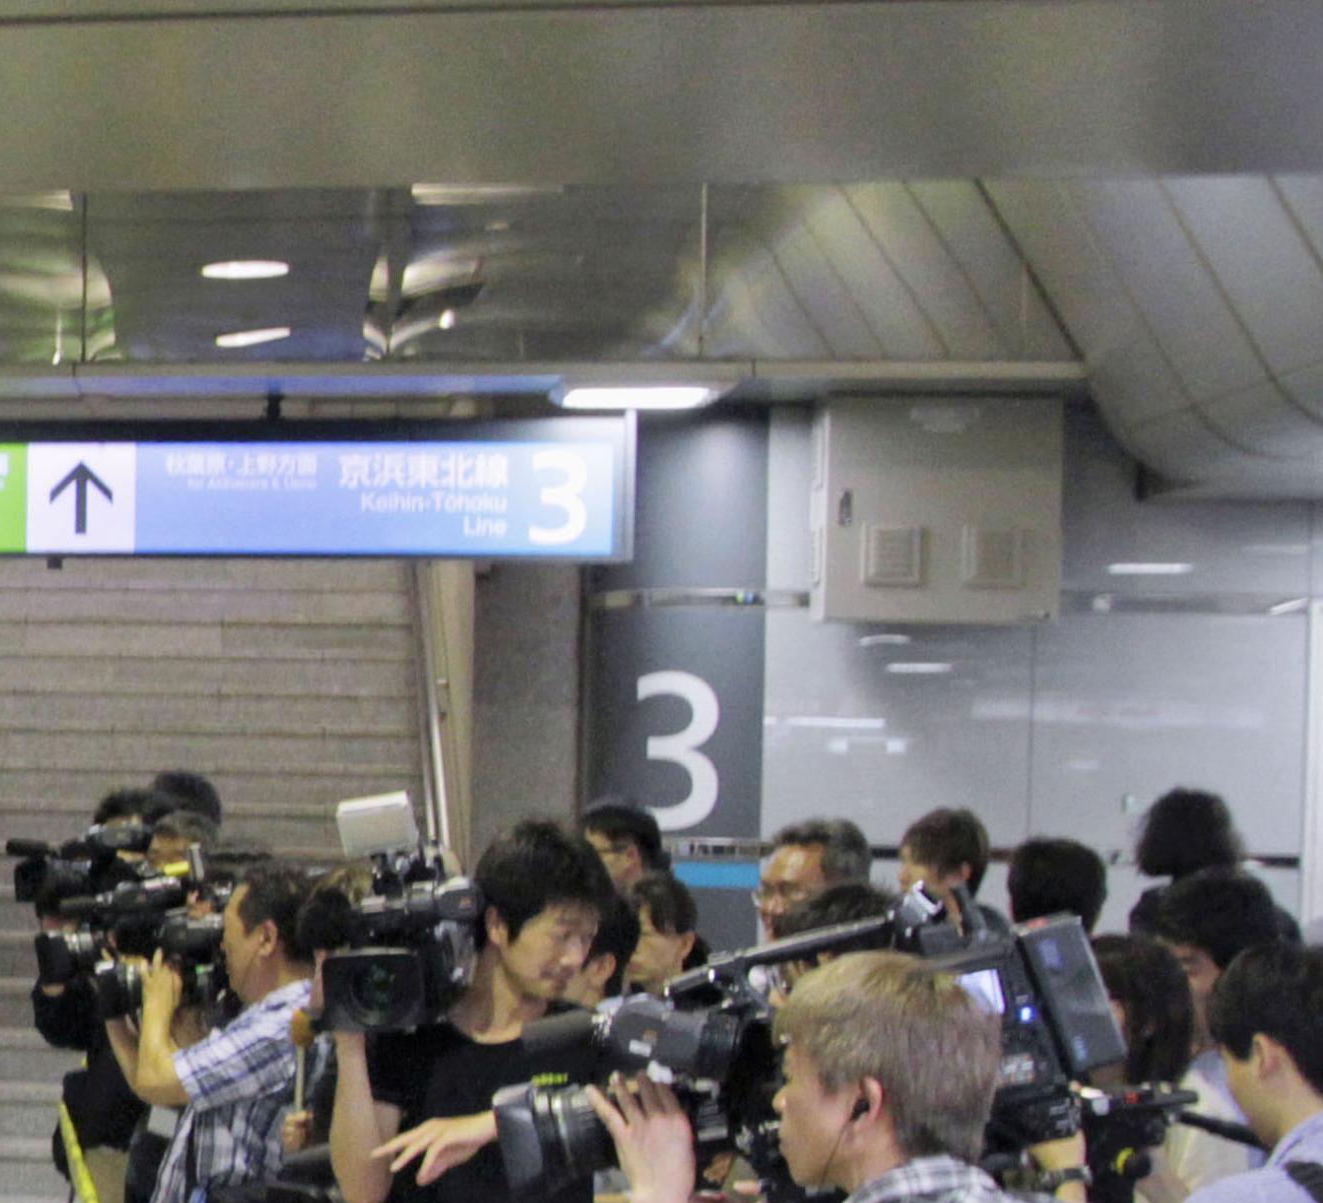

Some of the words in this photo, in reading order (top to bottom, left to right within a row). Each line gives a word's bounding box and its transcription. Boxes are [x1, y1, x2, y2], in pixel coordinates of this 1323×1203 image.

[337, 452, 508, 489] 京浜東北線
[528, 450, 588, 545] 3
[463, 516, 507, 537] Line
[636, 669, 720, 832] 3
